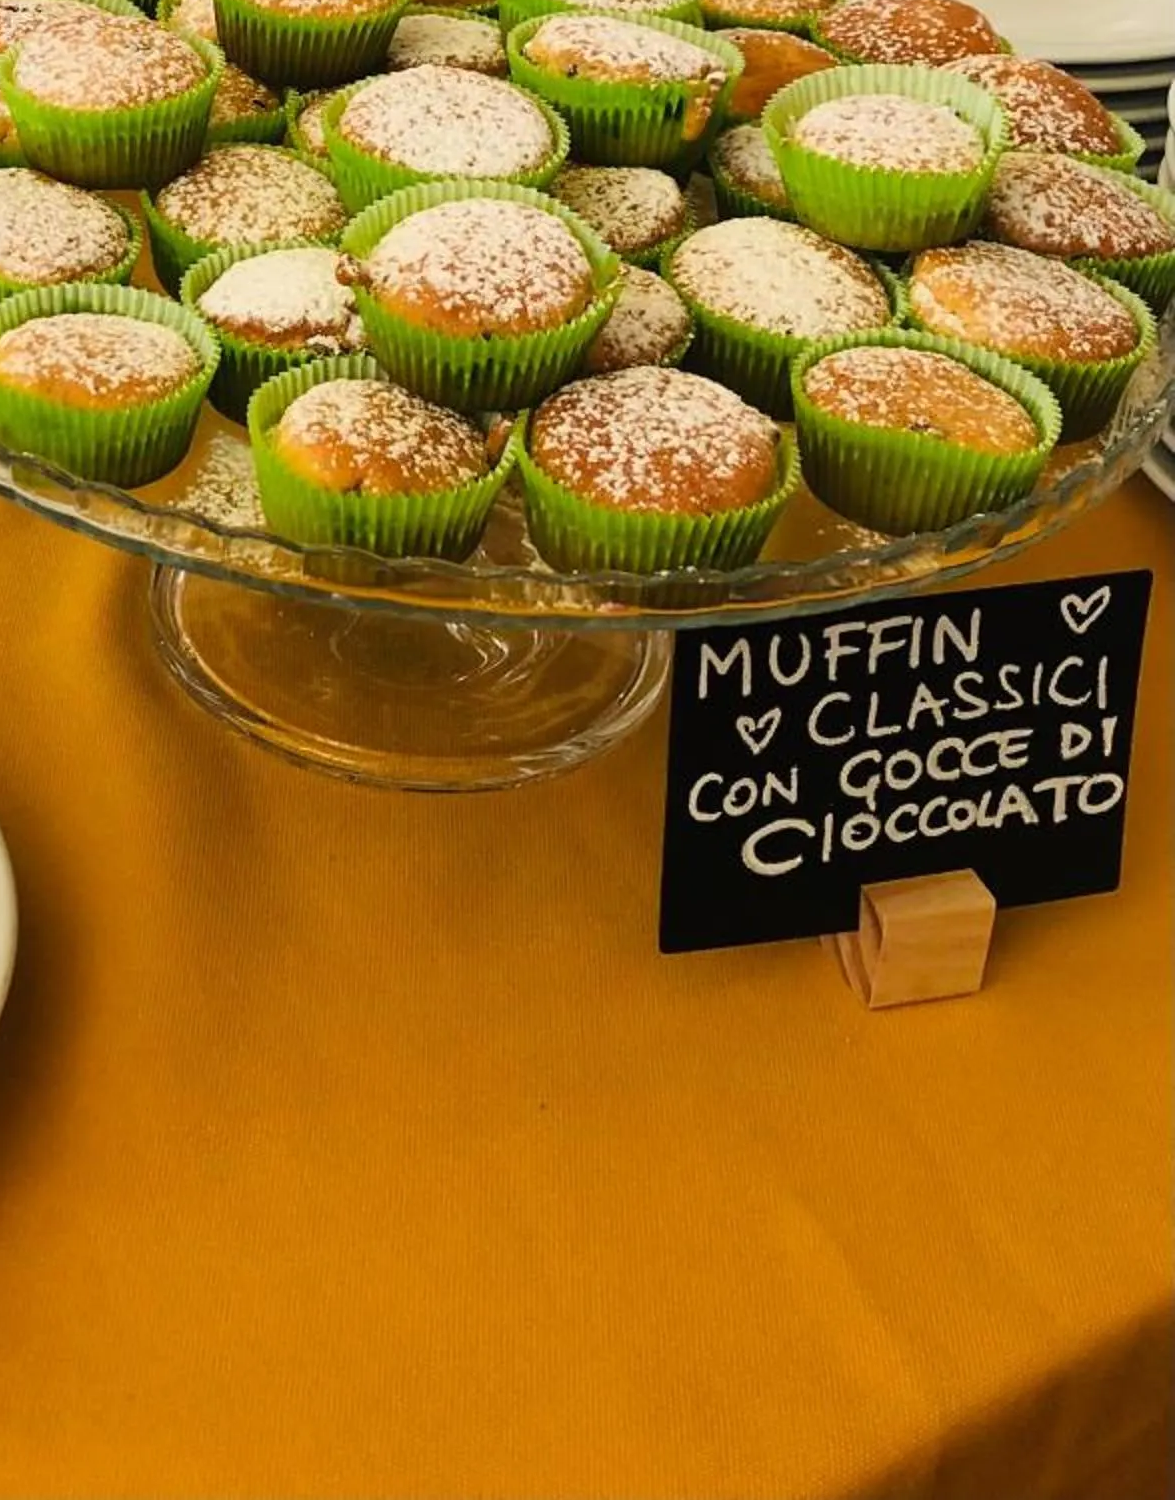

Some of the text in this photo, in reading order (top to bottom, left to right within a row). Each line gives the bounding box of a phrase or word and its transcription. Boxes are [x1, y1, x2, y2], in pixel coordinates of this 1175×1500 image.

[698, 608, 981, 699] MUFFIN
[808, 655, 1108, 746] CLASSICI
[688, 715, 1118, 822] CON GOCCE DI
[741, 773, 1124, 876] CIOCCOLATO
